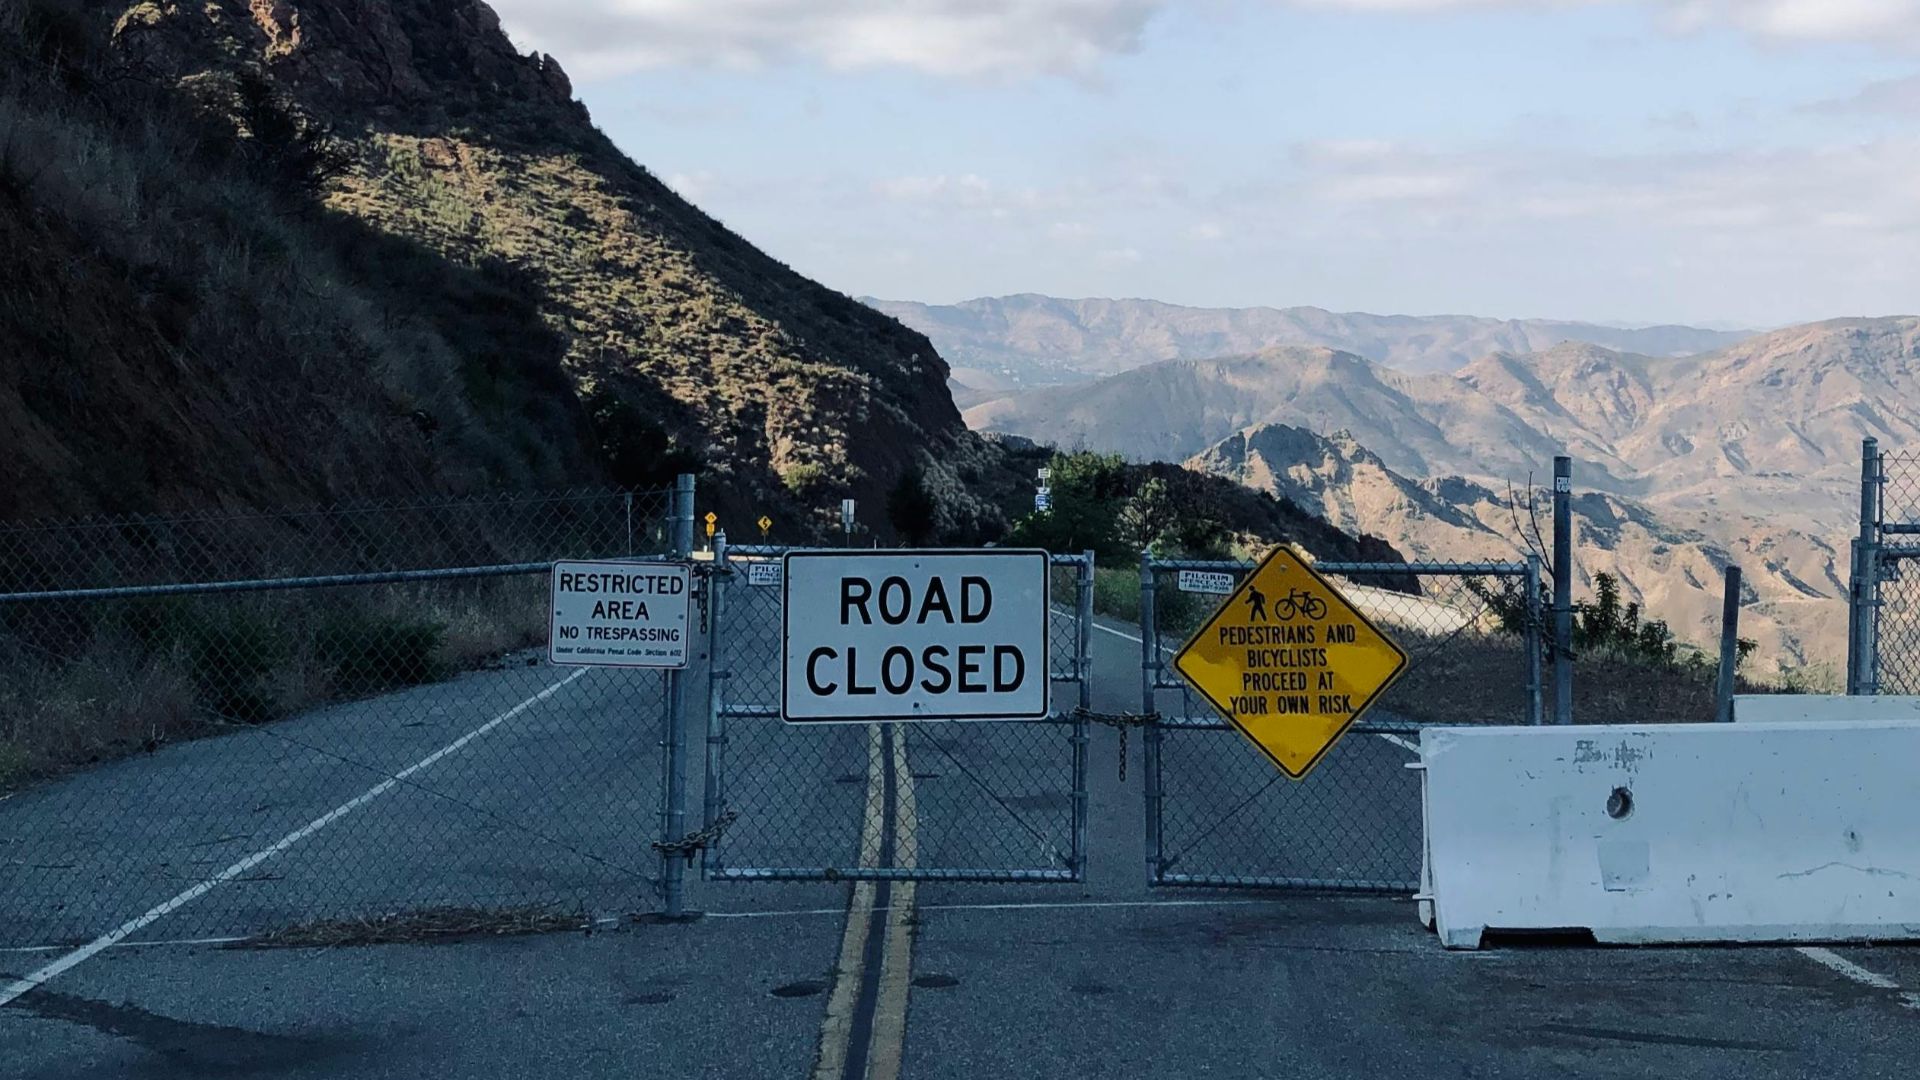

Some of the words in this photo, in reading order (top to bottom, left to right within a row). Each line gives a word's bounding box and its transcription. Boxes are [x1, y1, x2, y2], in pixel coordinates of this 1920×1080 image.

[559, 572, 684, 595] RESTRICTED
[591, 600, 650, 621] AREA
[840, 576, 993, 625] ROAD
[559, 625, 579, 640] NO
[586, 626, 680, 642] TRESPASSING
[1219, 624, 1316, 645] PEDESTRIANS
[1325, 624, 1357, 643] AND
[556, 646, 574, 654] Under
[576, 646, 606, 655] California
[607, 647, 625, 655] Penal
[627, 648, 642, 656] Code
[645, 648, 668, 657] Section
[1247, 647, 1328, 668] BICYCLISTS
[806, 645, 1026, 697] CLOSED
[1242, 671, 1307, 692] PROCEED
[1317, 671, 1334, 691] AT
[1229, 696, 1269, 715] YOUR
[1277, 695, 1310, 714] OWN
[1318, 695, 1353, 714] RISK
